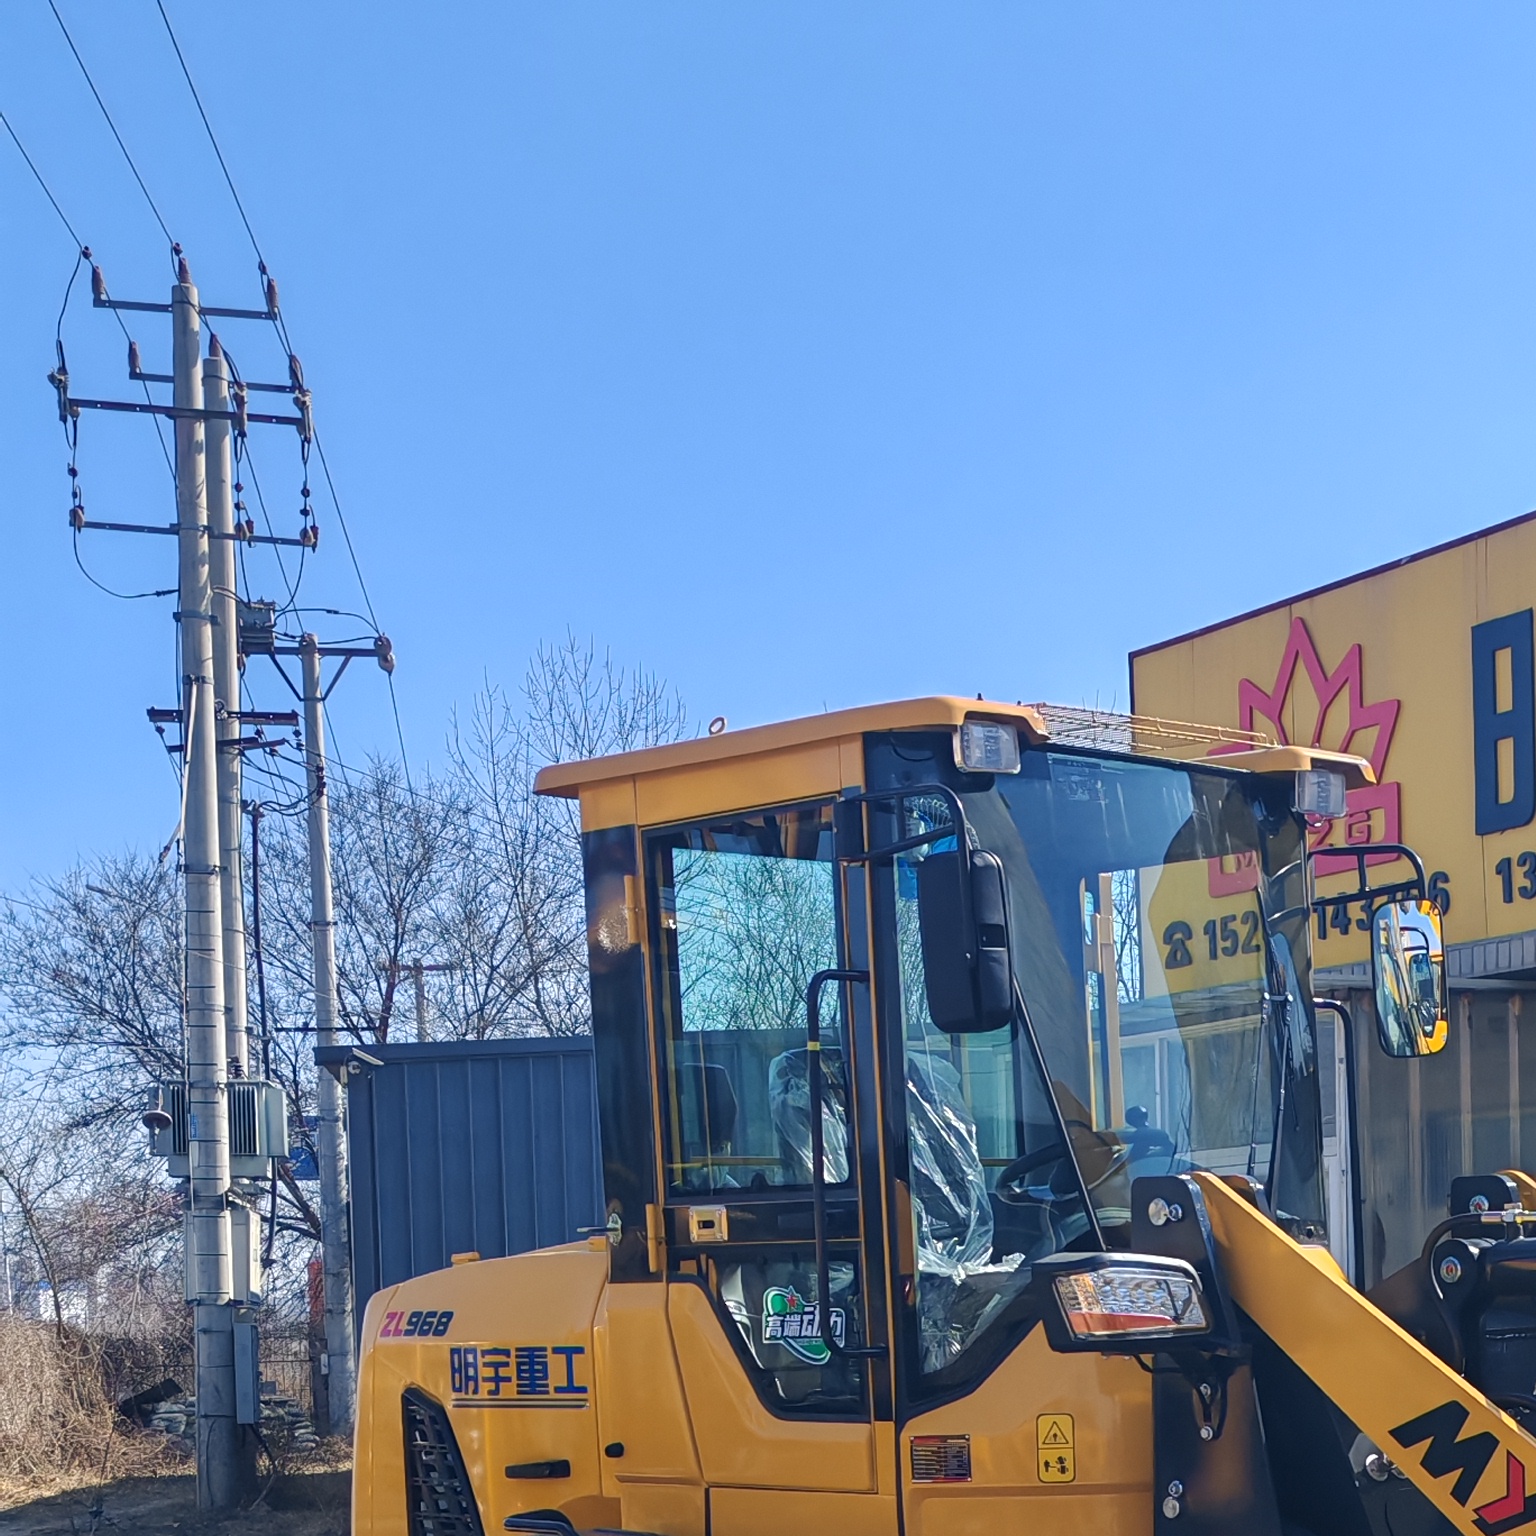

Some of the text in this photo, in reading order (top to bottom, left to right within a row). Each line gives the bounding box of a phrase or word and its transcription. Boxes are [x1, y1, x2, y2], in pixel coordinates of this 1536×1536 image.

[379, 1310, 455, 1338] ZL968
[449, 1346, 590, 1396] 明宇重工
